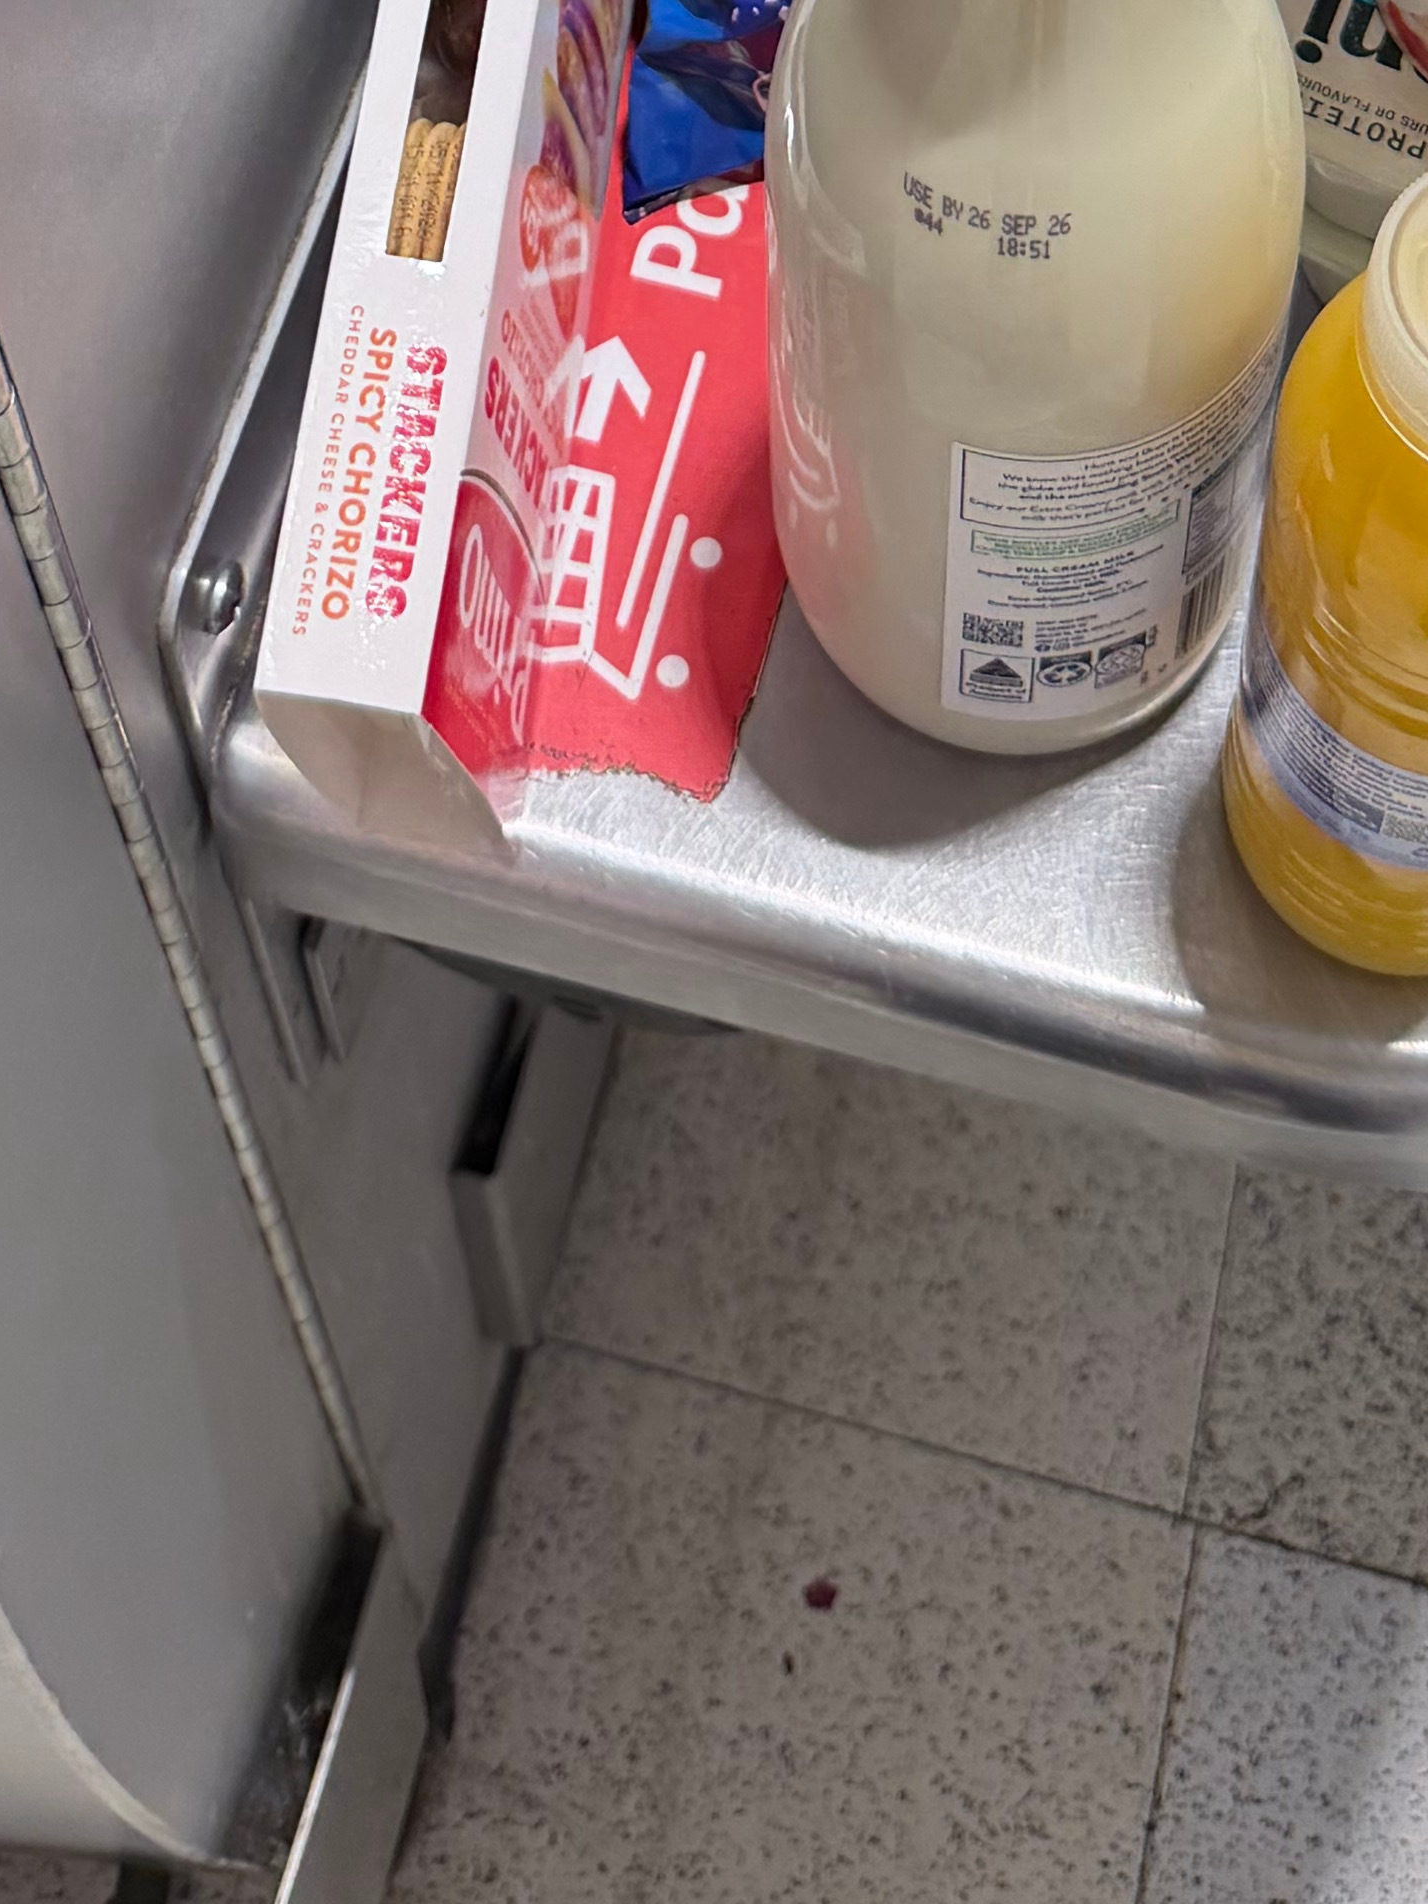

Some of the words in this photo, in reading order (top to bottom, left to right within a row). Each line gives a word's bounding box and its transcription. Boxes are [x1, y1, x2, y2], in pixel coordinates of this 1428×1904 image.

[904, 171, 933, 210] USE
[942, 195, 964, 220] BY
[968, 206, 991, 230] 26
[1002, 213, 1036, 236] SEP
[1048, 213, 1072, 236] 26
[997, 237, 1051, 259] 18:51
[341, 303, 366, 411] CHEDDAR
[359, 327, 398, 424] SPICY
[324, 415, 348, 503] CHEESE
[364, 342, 449, 624] STACKERS
[322, 430, 379, 622] CHORIZO
[291, 524, 327, 638] CRACKERS
